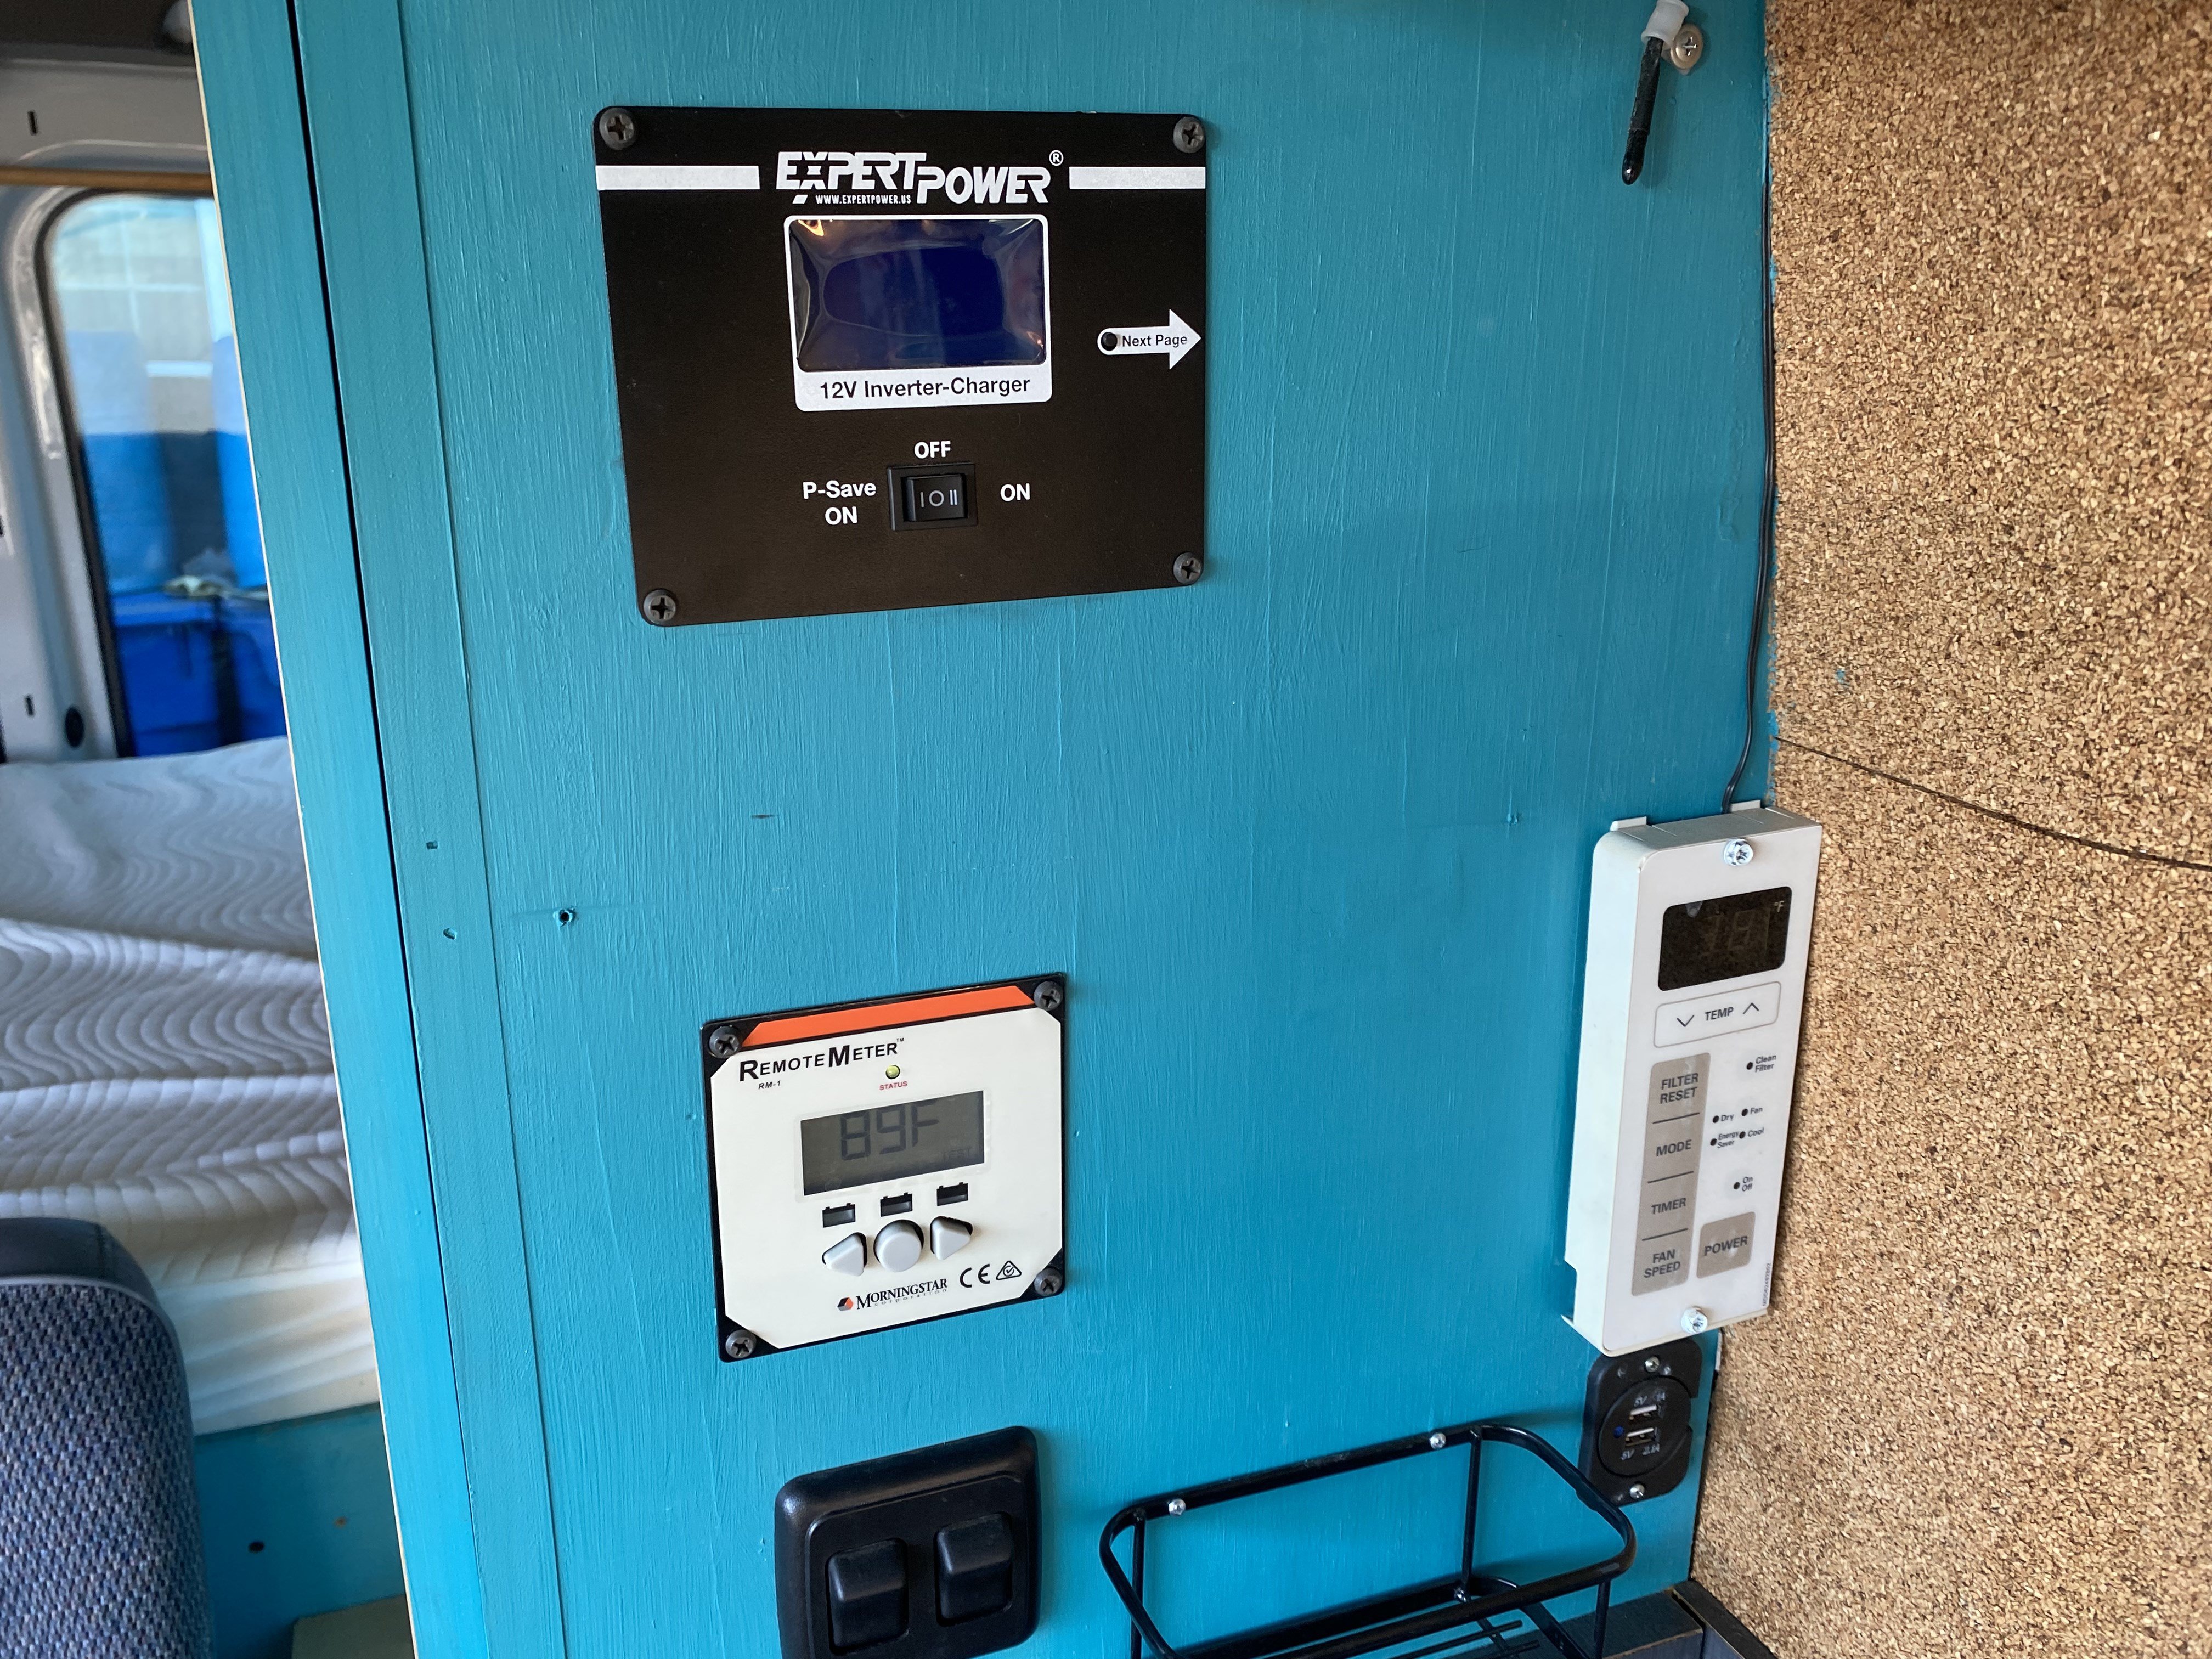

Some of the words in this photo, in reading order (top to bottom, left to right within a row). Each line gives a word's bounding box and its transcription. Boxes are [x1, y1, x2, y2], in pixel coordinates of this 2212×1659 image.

[815, 194, 911, 205] WWW.EXPERTPOWER.US
[1122, 335, 1152, 347] Next
[1155, 334, 1187, 348] Page
[820, 381, 857, 399] 12V
[865, 377, 1031, 397] Inverter-Charger
[914, 441, 951, 459] OFF
[803, 481, 877, 499] P-Save
[1000, 483, 1030, 501] ON
[825, 506, 857, 525] ON
[1705, 1006, 1734, 1022] TEMP
[1756, 1054, 1776, 1064] Clean
[1755, 1063, 1774, 1073] Filter
[758, 1080, 781, 1090] RM-1
[879, 1081, 908, 1091] STATUS
[1661, 1073, 1699, 1090] FILTER
[1660, 1087, 1698, 1104] RESET
[1721, 1114, 1734, 1122] Dry
[1750, 1107, 1763, 1115] Fan
[840, 1098, 940, 1161] 89F
[1718, 1131, 1740, 1141] Energy
[1747, 1127, 1764, 1137] Cool
[1656, 1139, 1692, 1157] MODE
[1742, 1183, 1753, 1192] Off
[1651, 1197, 1686, 1215] TIMER
[1704, 1235, 1748, 1256] POWER
[1652, 1249, 1675, 1263] FAN
[1644, 1261, 1681, 1278] SPEED
[856, 1278, 947, 1310] MORNINGSTAR
